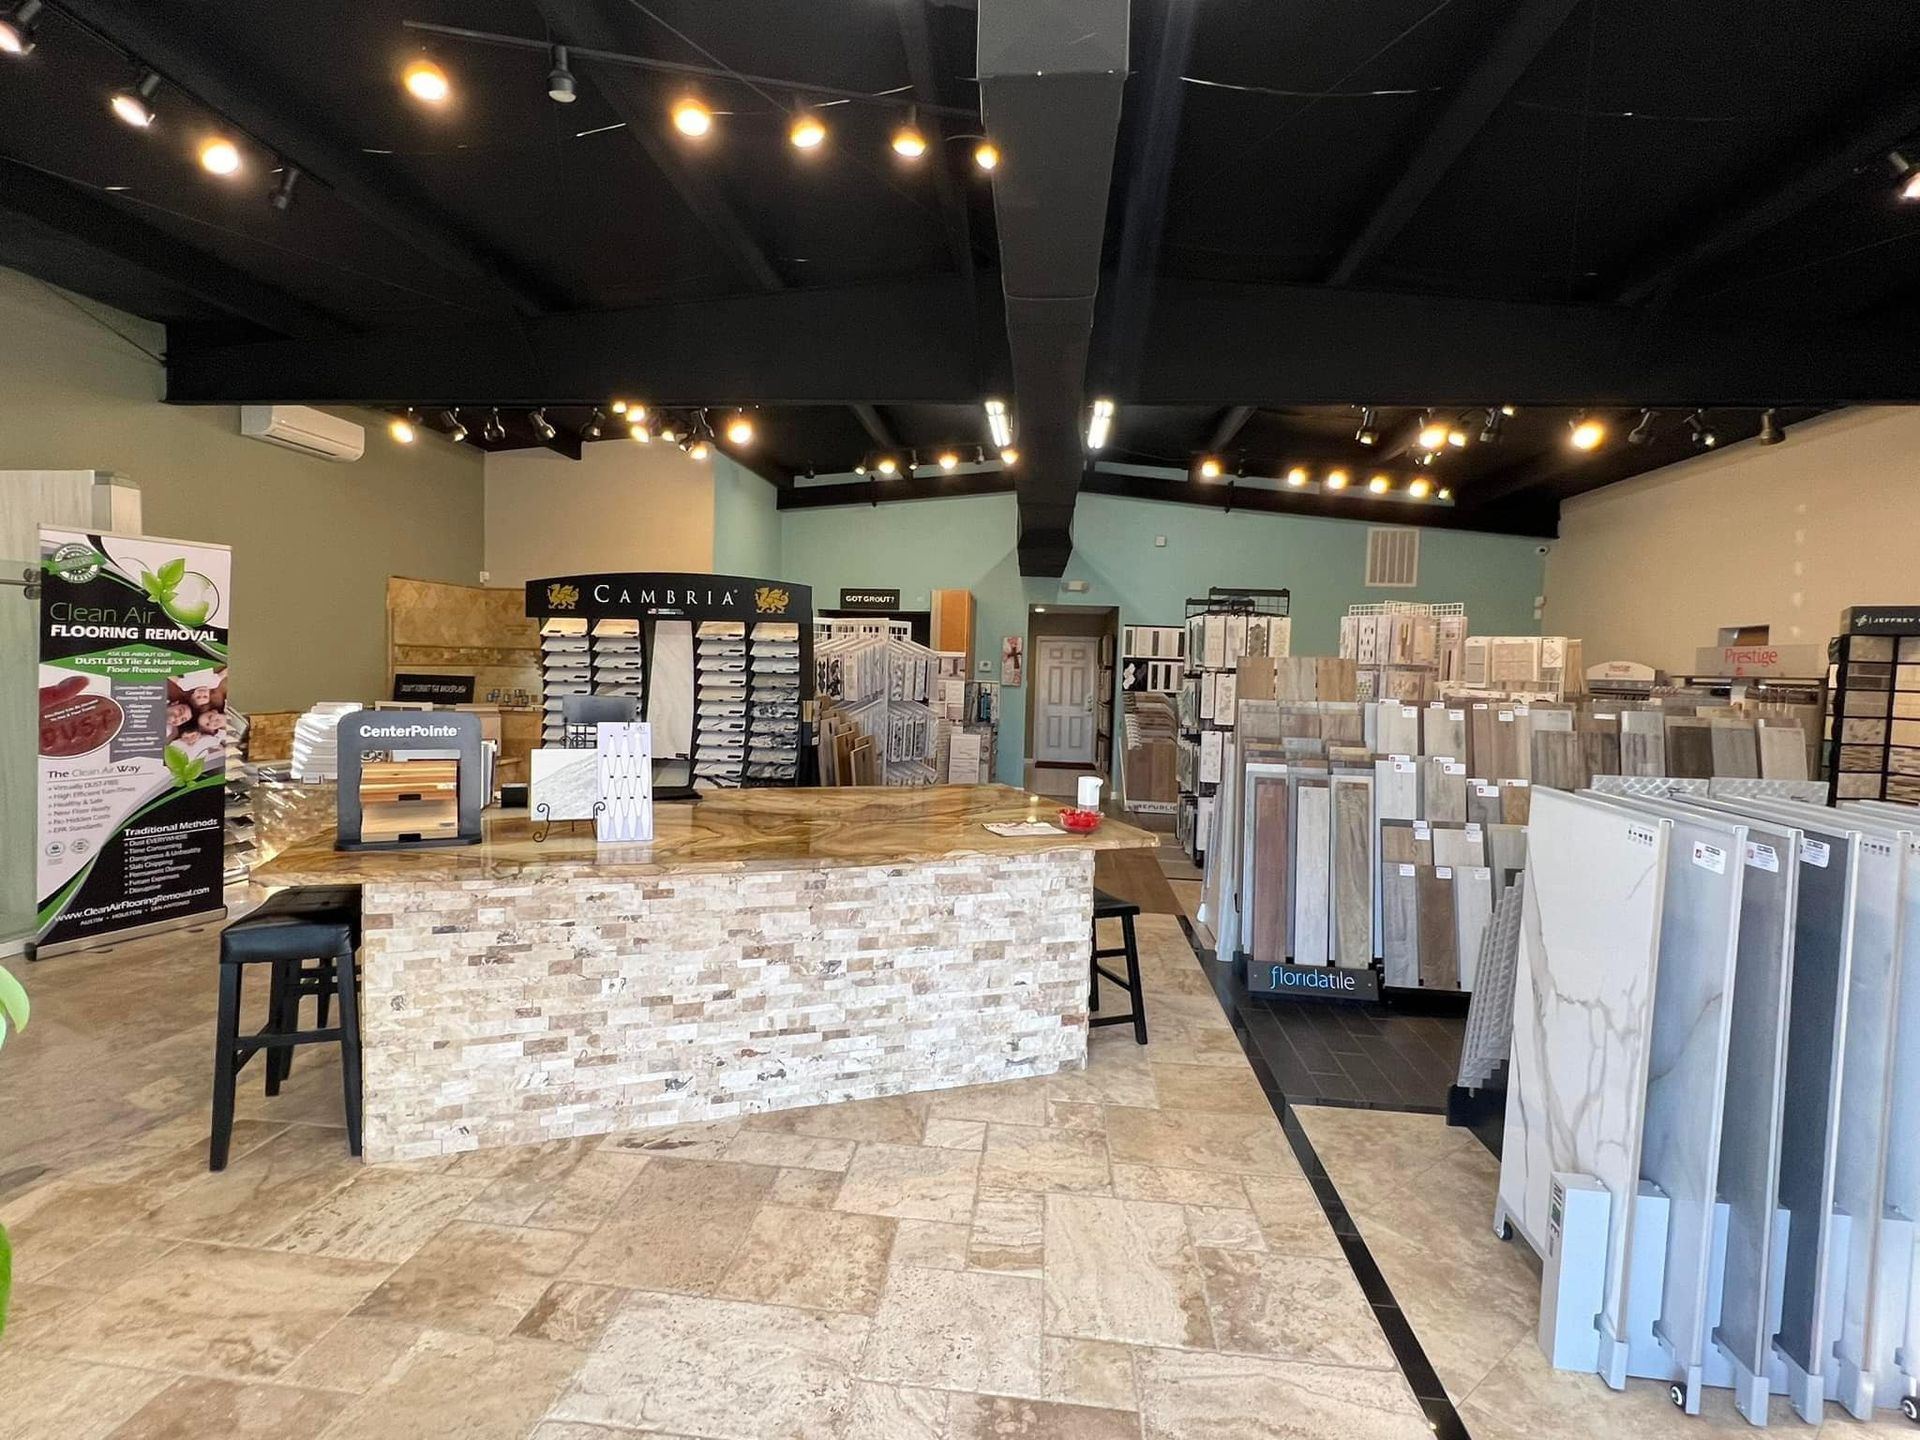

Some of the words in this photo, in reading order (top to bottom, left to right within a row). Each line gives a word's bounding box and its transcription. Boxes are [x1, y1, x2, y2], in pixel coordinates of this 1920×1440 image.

[593, 584, 735, 606] CAMBRIA
[863, 595, 895, 603] GROUT?
[50, 601, 117, 622] Clean
[123, 606, 157, 624] Air
[50, 624, 139, 640] FLOORING
[145, 627, 218, 642] REMOVAL
[75, 657, 123, 665] DUSTLESS
[1724, 648, 1778, 667] Prestige
[132, 666, 172, 674] Removal
[359, 725, 458, 738] CenterPointe
[48, 770, 70, 779] The
[71, 768, 100, 777] Clean
[102, 766, 115, 775] Air
[116, 765, 141, 774] Way
[124, 822, 179, 837] Traditional
[179, 818, 218, 830] Methods
[54, 887, 210, 922] www.CleanAirFlooringRemoval.com
[111, 909, 143, 919] HOUSTON
[1270, 965, 1356, 991] floridatile
